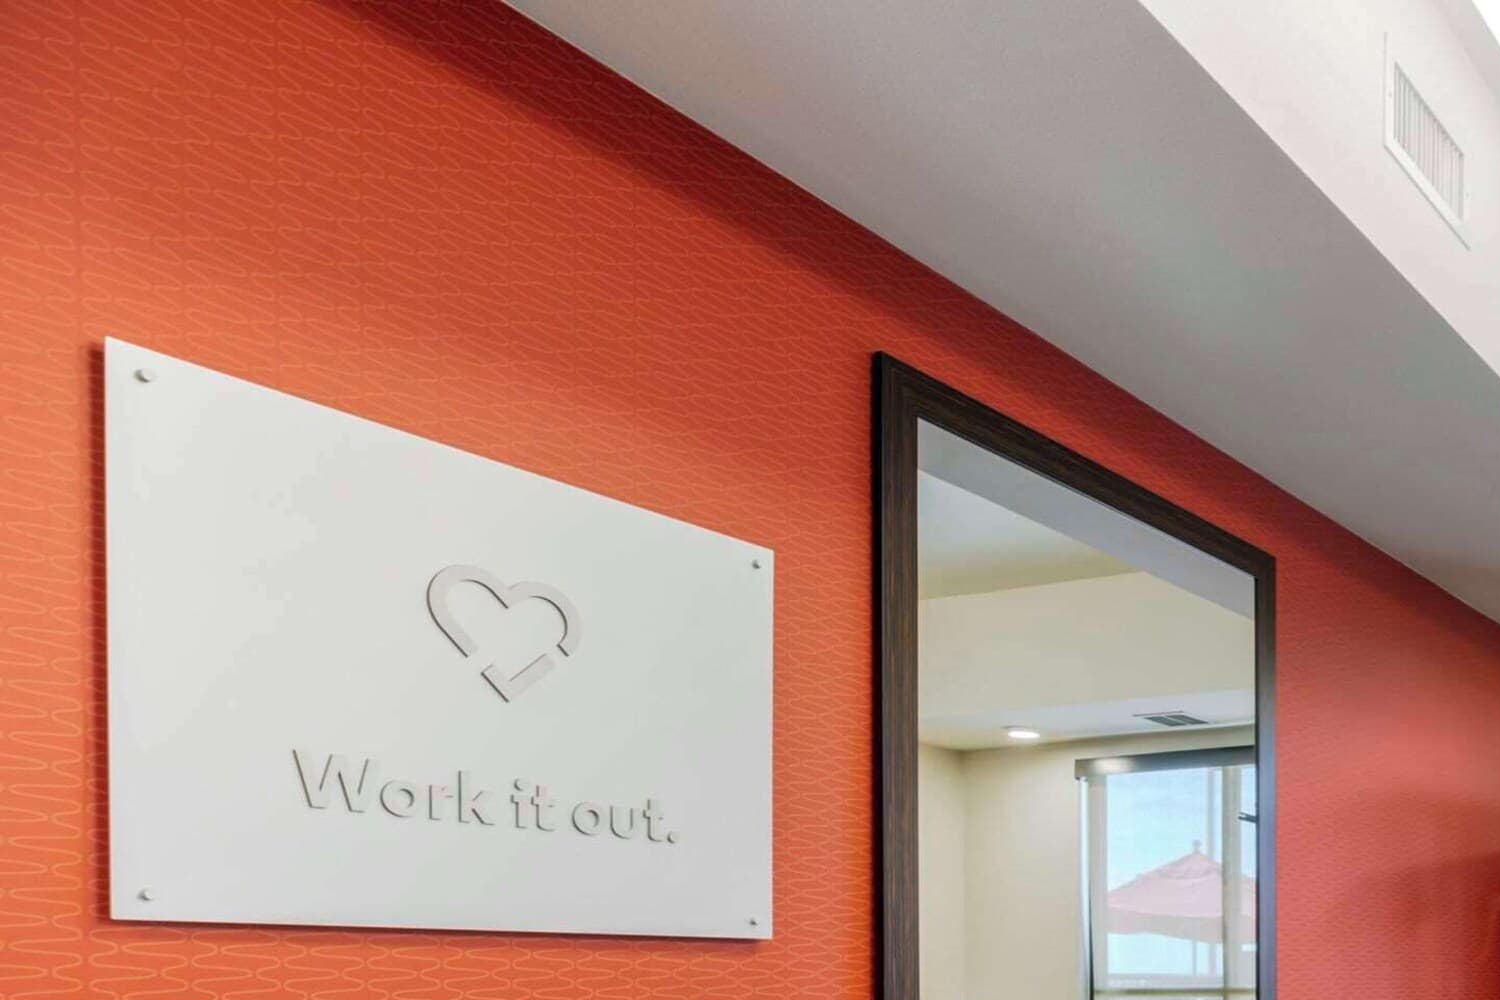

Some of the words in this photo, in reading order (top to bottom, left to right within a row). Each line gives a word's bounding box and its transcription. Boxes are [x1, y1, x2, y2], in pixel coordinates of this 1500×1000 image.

[291, 749, 495, 827] Work
[509, 778, 555, 832] it
[570, 799, 681, 844] out.
